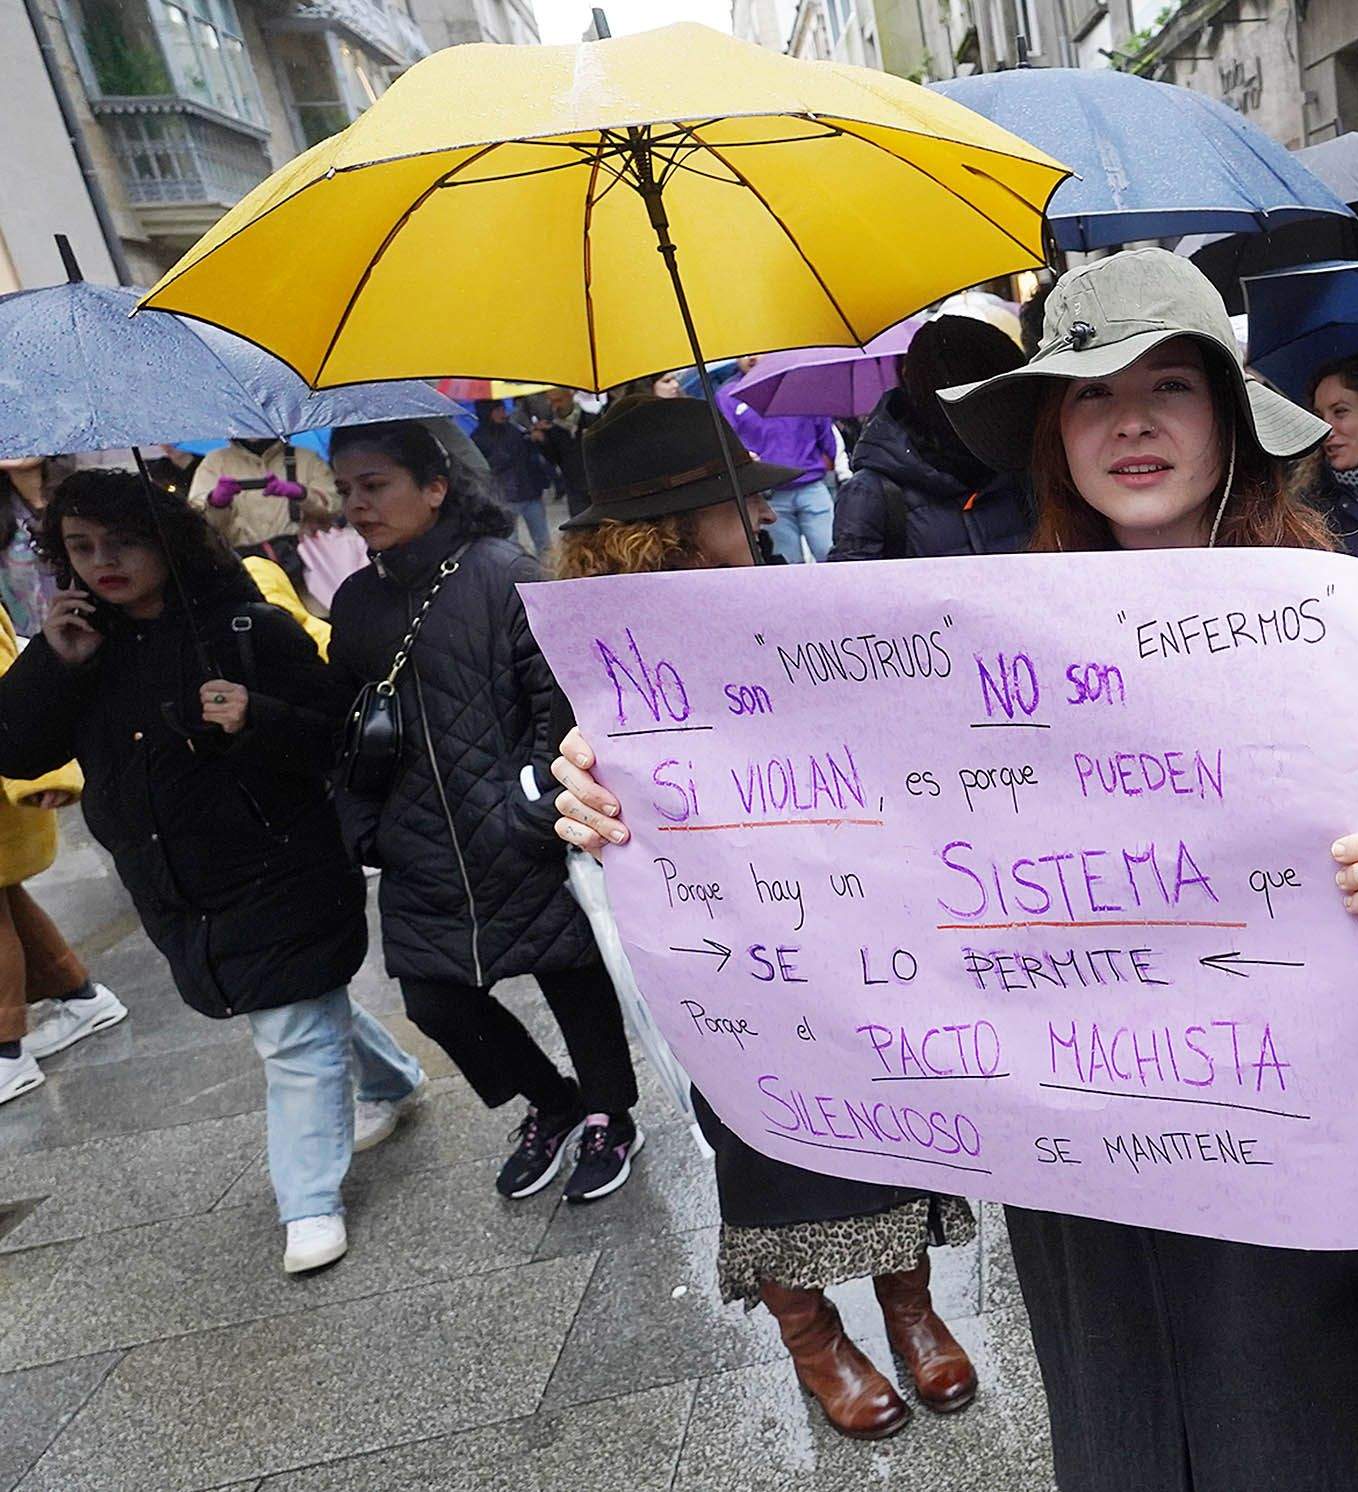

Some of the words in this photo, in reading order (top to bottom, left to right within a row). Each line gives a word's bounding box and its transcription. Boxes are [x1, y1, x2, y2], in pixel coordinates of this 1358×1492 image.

[593, 628, 690, 721] No
[724, 684, 772, 715] son
[753, 615, 952, 688] "MONSTRUOS"
[973, 652, 1039, 719] NO
[1066, 663, 1124, 705] son
[1117, 584, 1334, 659] "ENFERMOS"
[906, 772, 940, 796] es
[959, 765, 1038, 814] porque
[1074, 750, 1223, 799] PUEDEN
[654, 858, 723, 919] Porque
[750, 863, 804, 931] hay
[830, 874, 864, 898] un
[1249, 869, 1301, 919] que
[747, 944, 808, 982] SE
[860, 949, 917, 985] LO
[963, 948, 1169, 992] PERMITE
[680, 1000, 758, 1050] Porque
[797, 1016, 816, 1041] el
[856, 1020, 1007, 1076] PACTO
[1044, 1021, 1291, 1091] MACHISTA
[1035, 1137, 1081, 1164] SE
